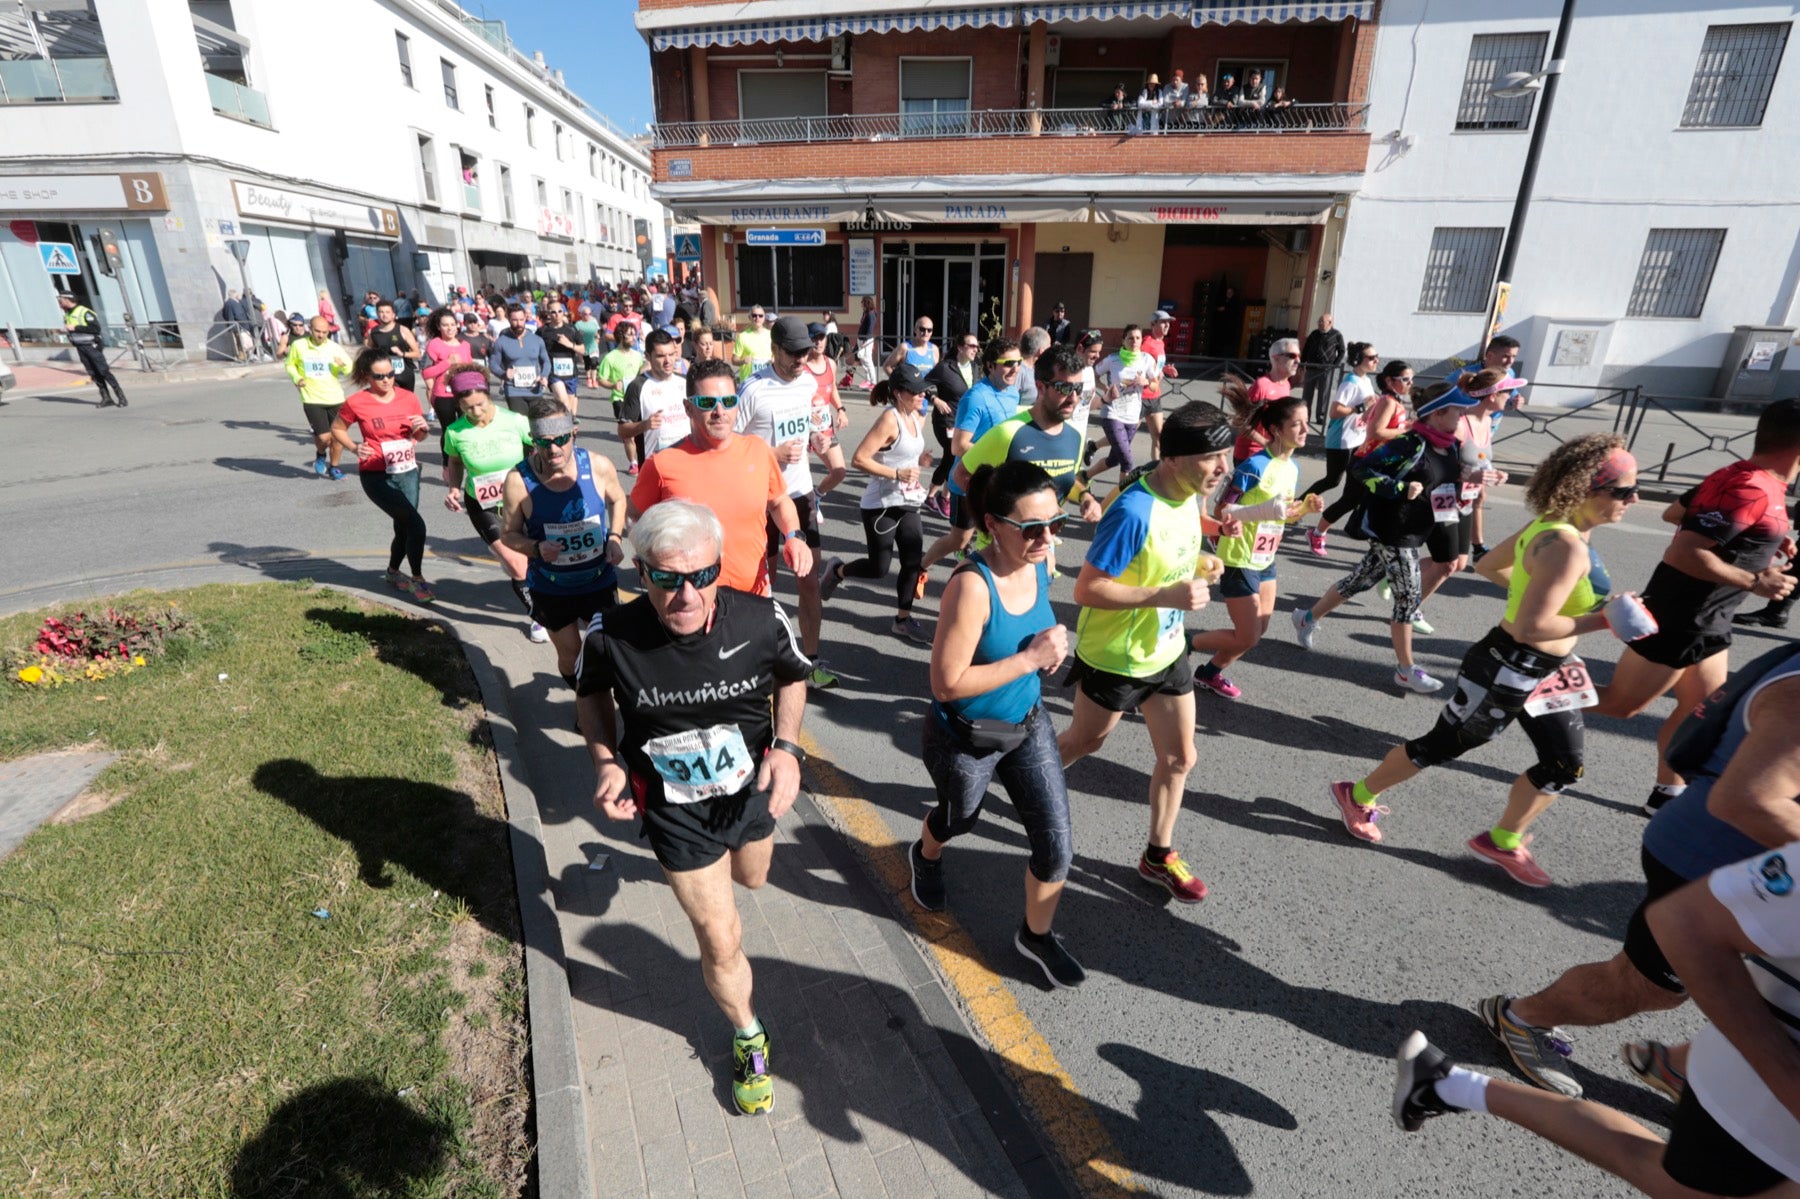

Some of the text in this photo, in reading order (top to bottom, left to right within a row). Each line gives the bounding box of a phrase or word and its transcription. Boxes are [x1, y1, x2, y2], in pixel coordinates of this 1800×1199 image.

[0, 190, 58, 200] HE SHOP
[132, 179, 154, 204] B
[247, 186, 293, 217] Beauty
[732, 206, 830, 222] RESTAURANTE
[945, 205, 1008, 220] PARADA
[386, 213, 395, 231] B
[748, 233, 779, 241] Granada
[312, 362, 324, 371] 82
[557, 362, 571, 370] 474
[1540, 667, 1586, 694] 39
[669, 746, 736, 782] 914
